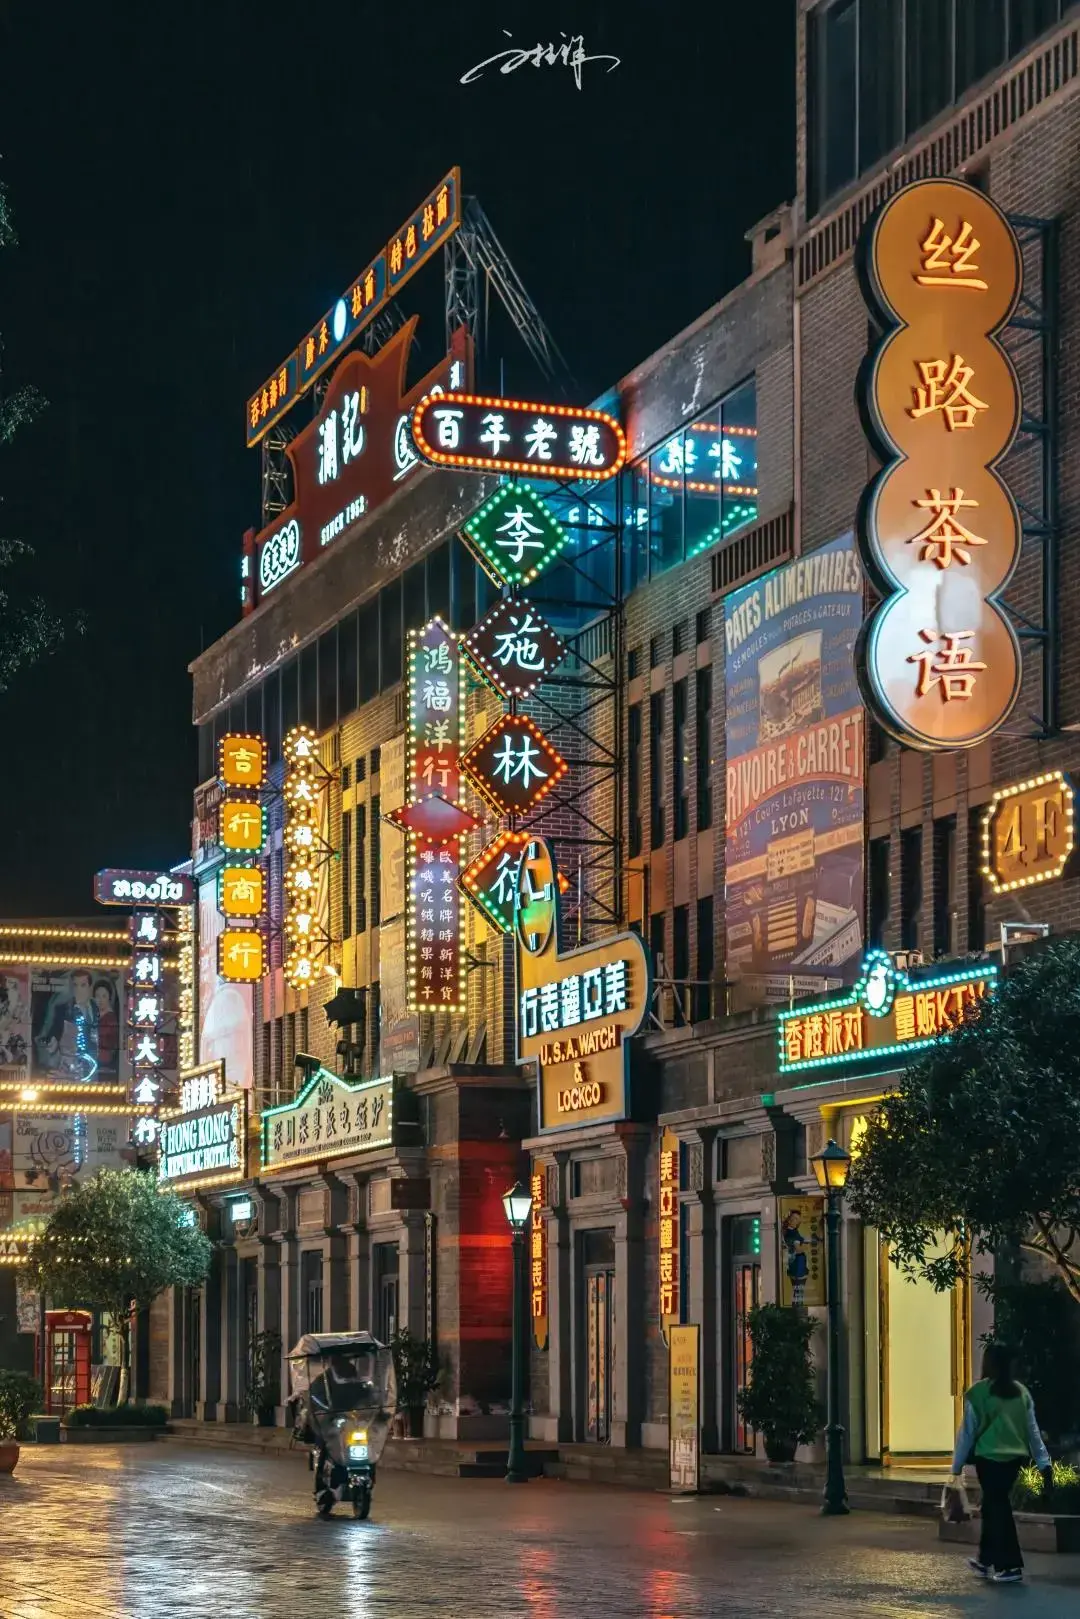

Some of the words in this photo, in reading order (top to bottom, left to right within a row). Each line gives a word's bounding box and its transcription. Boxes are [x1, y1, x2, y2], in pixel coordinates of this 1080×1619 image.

[433, 408, 606, 466] 百年老號
[908, 218, 989, 705] 丝路茶语
[764, 549, 861, 620] ALIMENTAIRES
[421, 640, 453, 788] 鴻福洋行
[727, 744, 787, 828] RIVOIRE
[797, 712, 862, 776] CARRET
[755, 800, 780, 824] Cours
[783, 788, 825, 809] Lafayette
[829, 786, 844, 802] 121
[771, 808, 810, 835] LYON
[1003, 793, 1063, 866] 4F
[578, 1025, 616, 1057] WATCH
[785, 1006, 864, 1062] 香橙派对
[557, 1082, 601, 1113] LOCKCO
[573, 1062, 583, 1083] &
[167, 1118, 198, 1154] HONG
[198, 1111, 229, 1144] KONG
